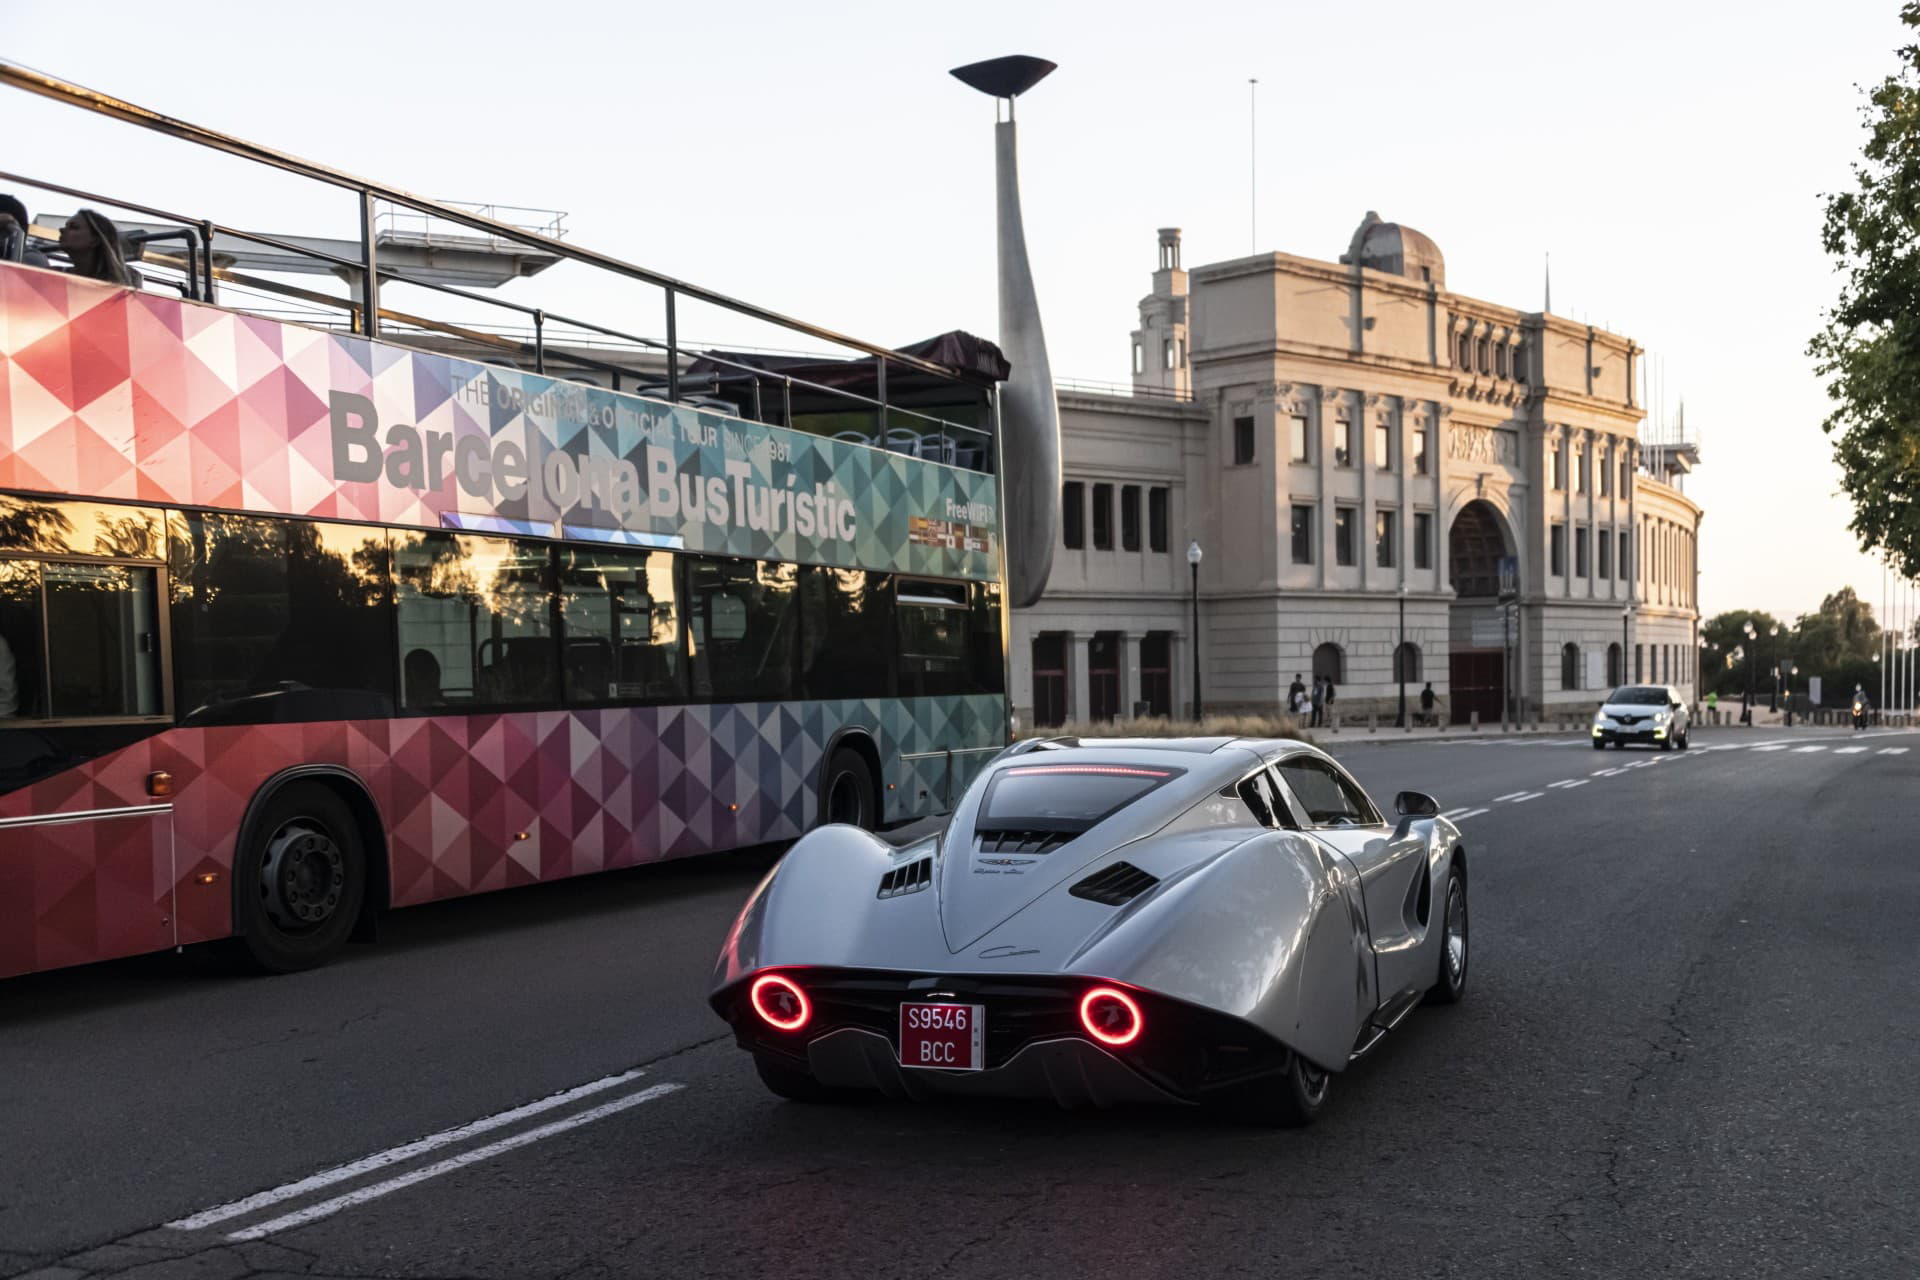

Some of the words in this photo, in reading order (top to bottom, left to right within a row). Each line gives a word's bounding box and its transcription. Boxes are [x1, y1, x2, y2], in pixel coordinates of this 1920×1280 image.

[451, 375, 489, 406] THE
[602, 406, 675, 439] OICIAL
[679, 424, 718, 449] TOUR
[762, 439, 791, 463] 987
[908, 1007, 967, 1030] S9546
[920, 1040, 955, 1062] BCC
